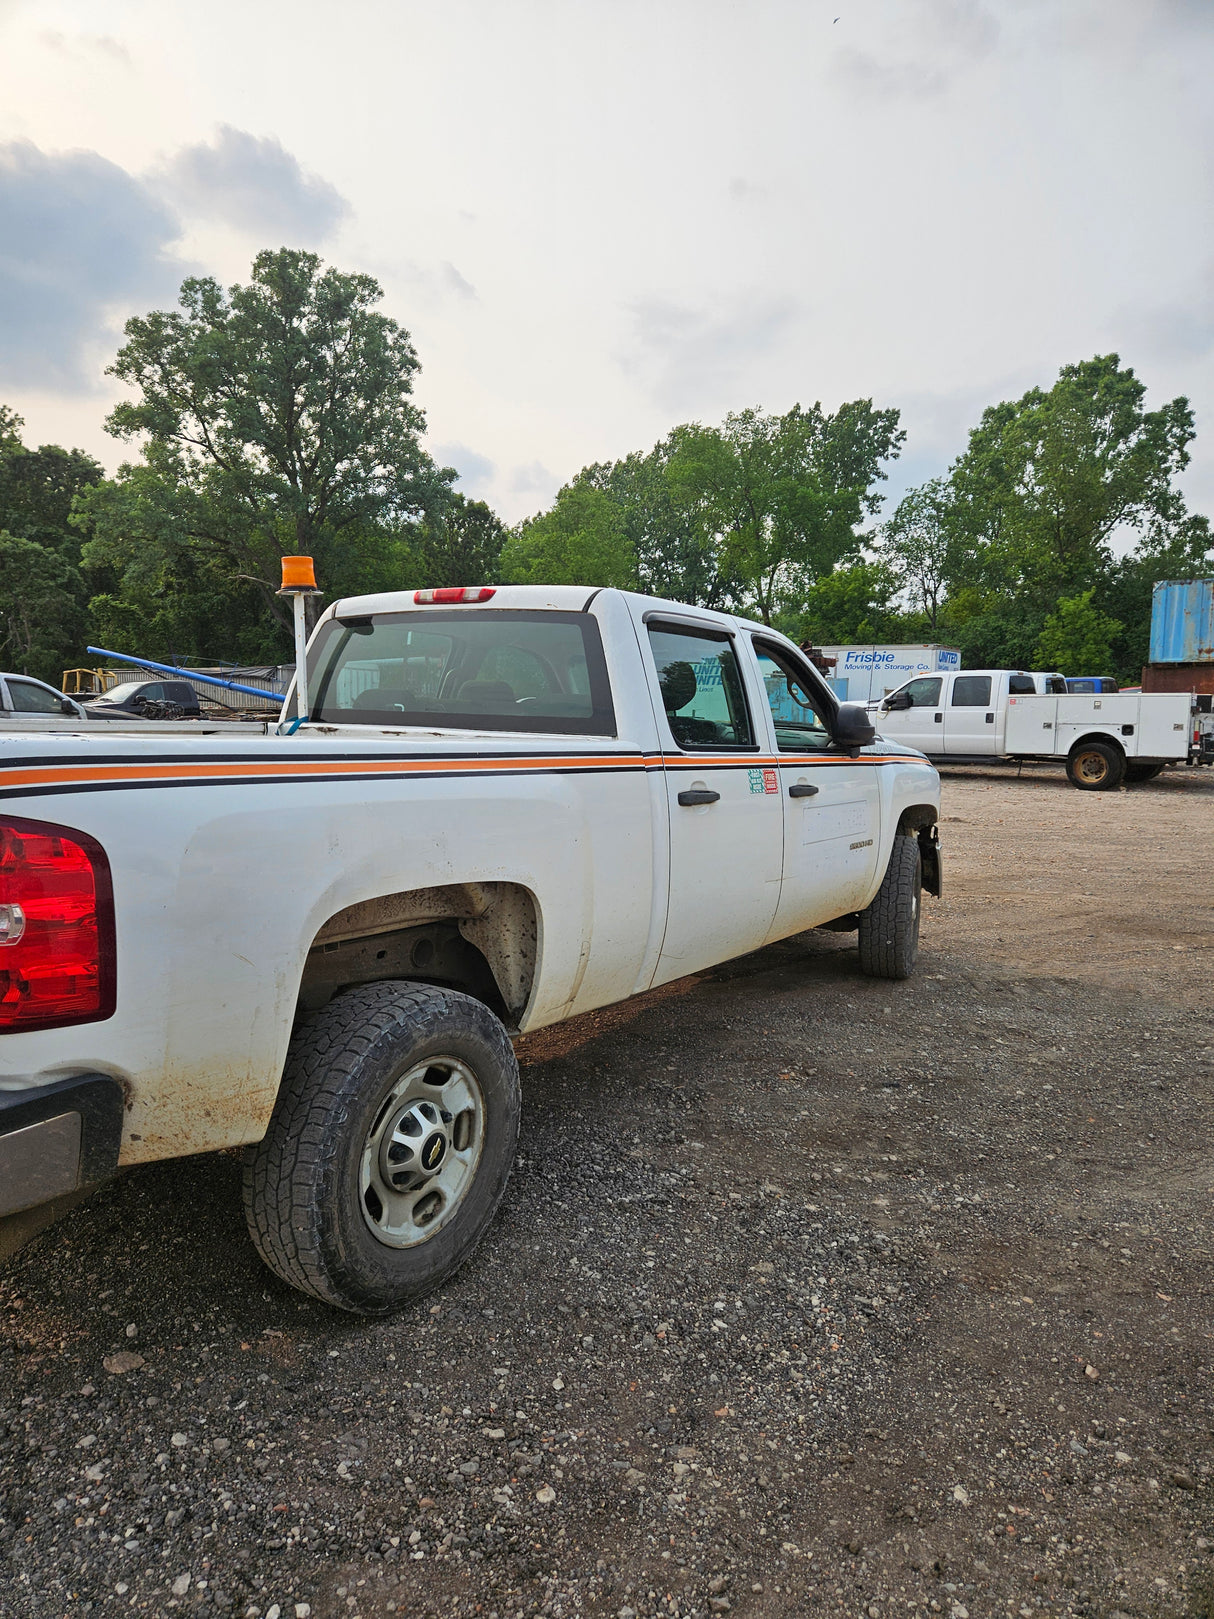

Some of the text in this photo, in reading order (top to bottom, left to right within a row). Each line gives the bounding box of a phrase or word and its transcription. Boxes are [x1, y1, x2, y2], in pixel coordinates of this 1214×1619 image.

[845, 651, 895, 663] Frisbie
[938, 650, 958, 664] UNITED
[844, 663, 872, 672] Moving
[884, 663, 915, 671] Storage
